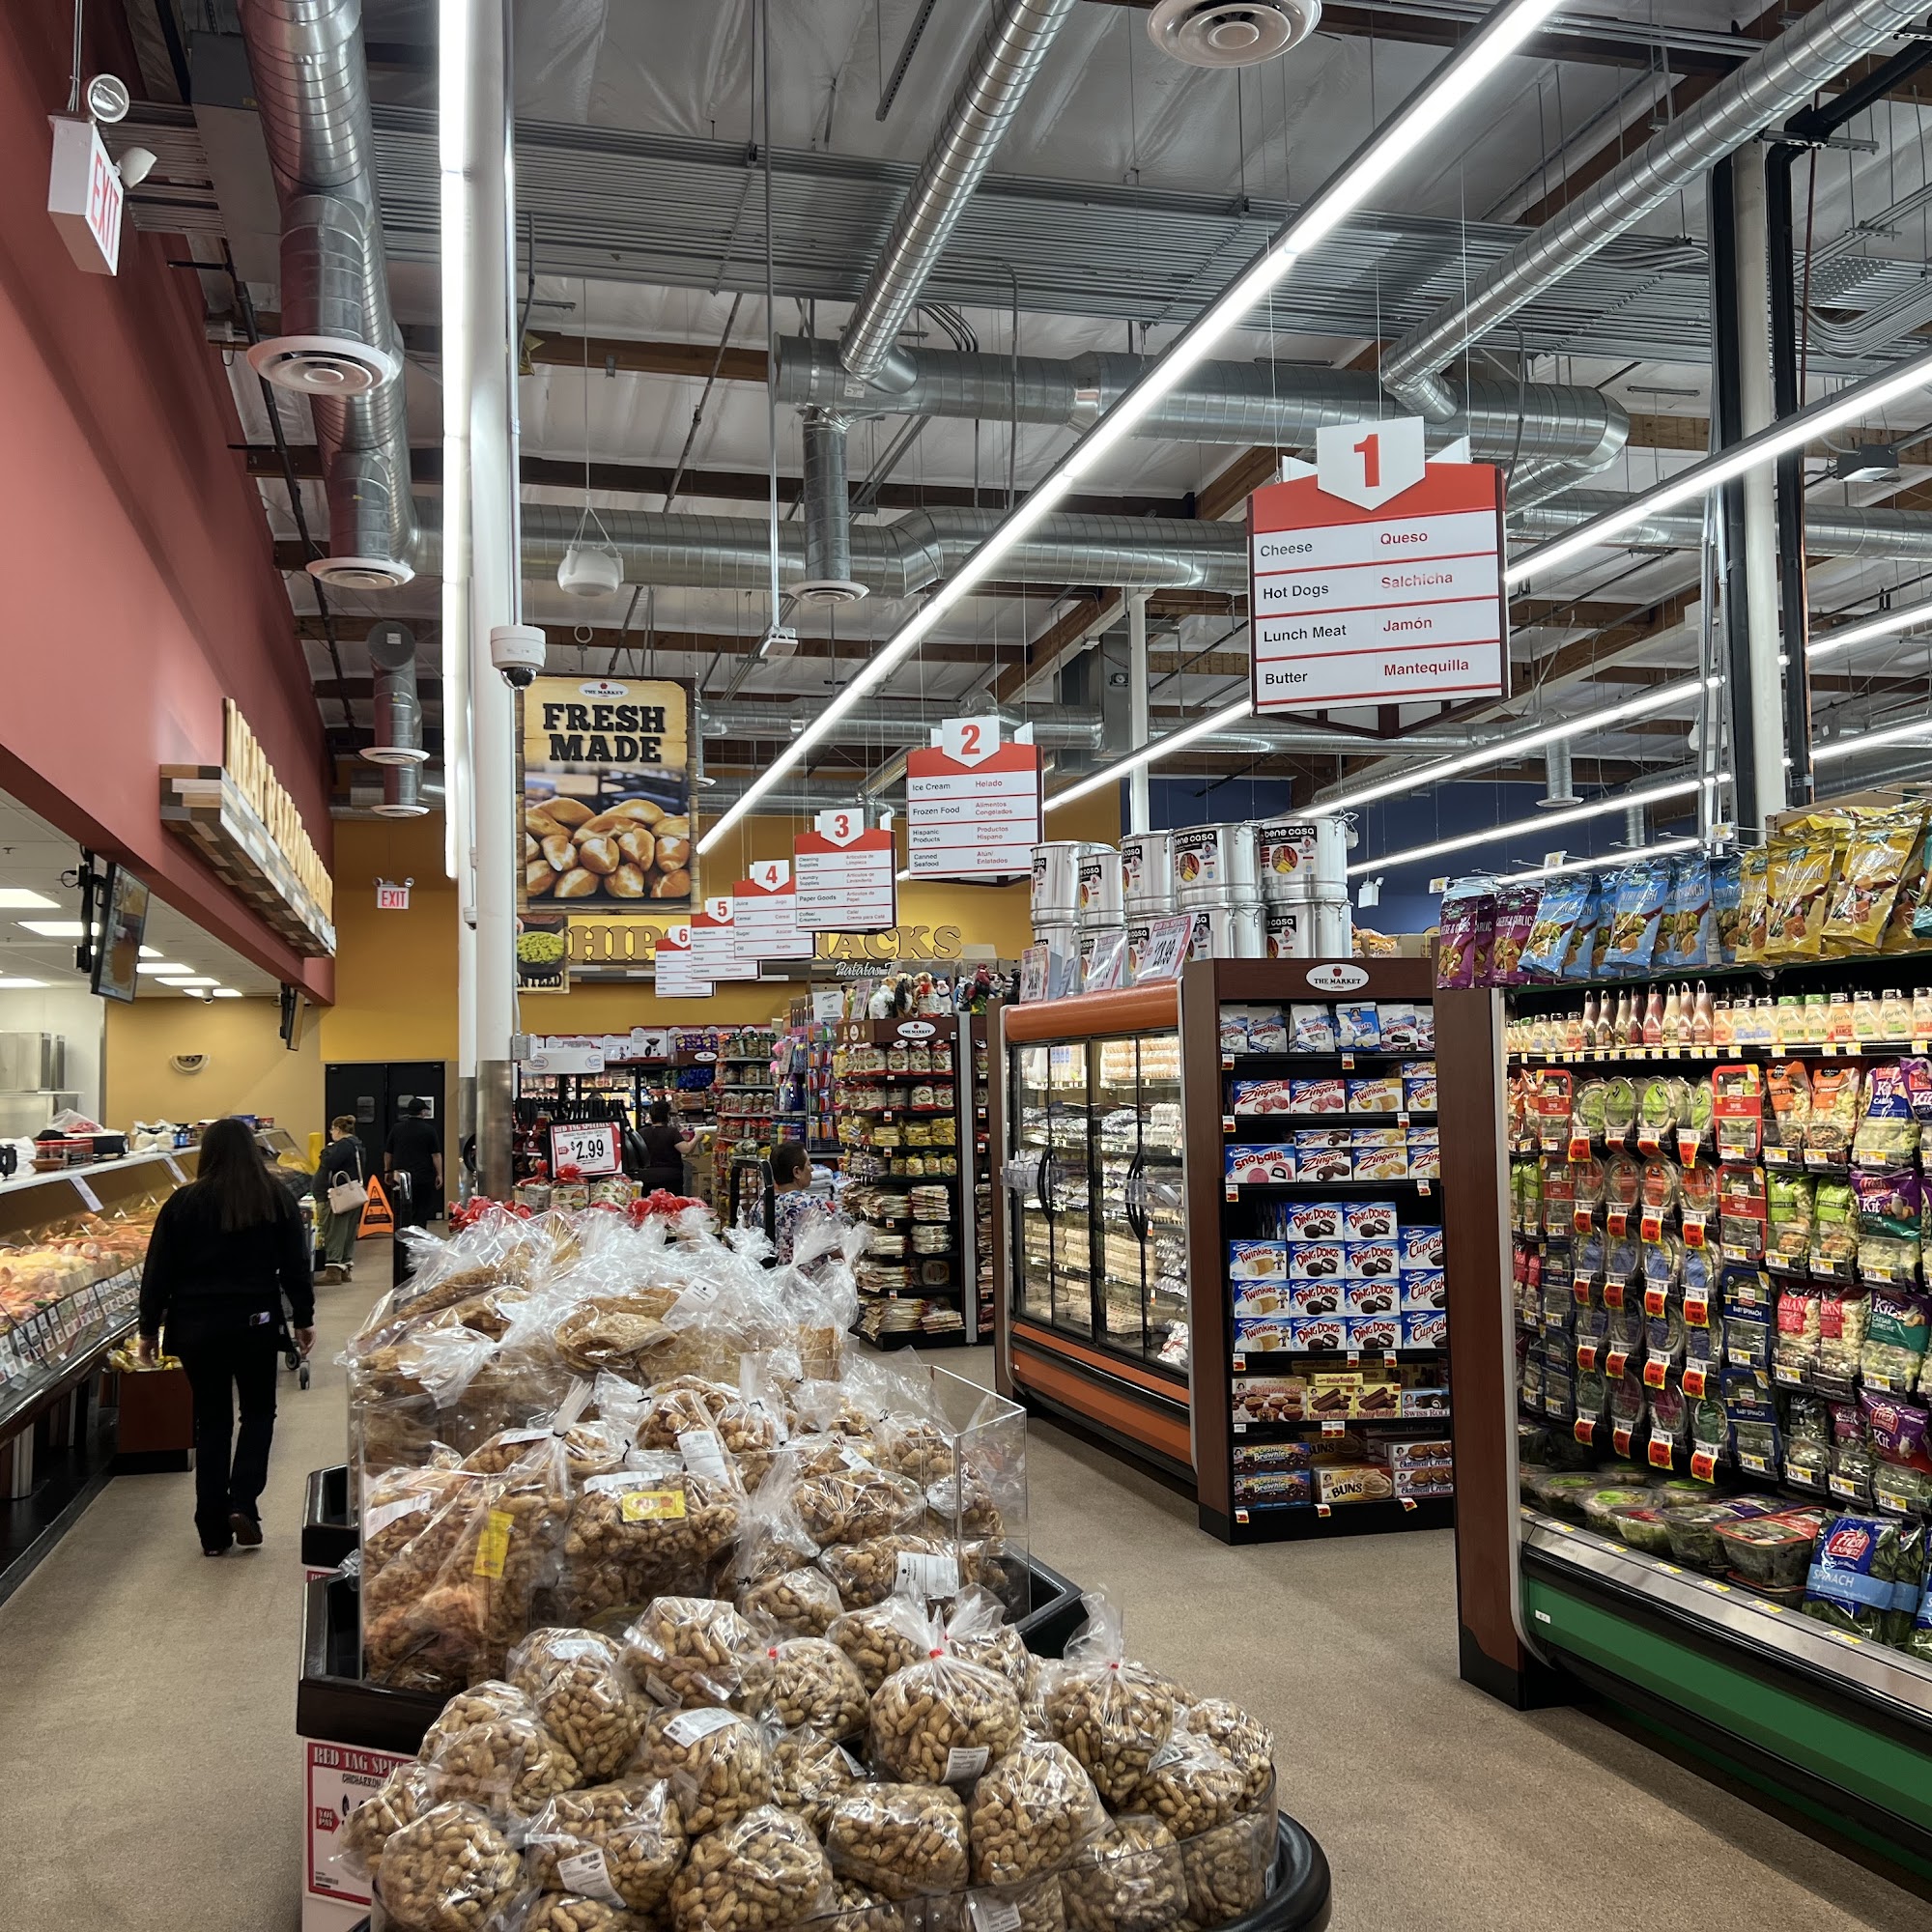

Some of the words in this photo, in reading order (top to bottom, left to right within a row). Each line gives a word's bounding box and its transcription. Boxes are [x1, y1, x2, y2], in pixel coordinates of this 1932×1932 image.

[90, 150, 120, 262] EXIT
[1353, 433, 1379, 488] 1
[1380, 532, 1428, 546] Queso
[1260, 542, 1313, 557] Cheese
[1380, 572, 1453, 588] Salchicha
[1263, 586, 1288, 600] Hot
[1292, 583, 1329, 598] Dogs
[1383, 616, 1433, 632] Jamón
[1264, 628, 1308, 642] Lunch
[1312, 624, 1347, 639] Meat
[1384, 659, 1469, 676] Mantequilla
[1264, 670, 1308, 685] Butter
[543, 703, 666, 733] FRESH
[960, 724, 980, 755] 2
[549, 733, 662, 763] MADE
[834, 814, 849, 838] 3
[1264, 828, 1287, 838] bene
[1289, 827, 1315, 837] casa
[1189, 833, 1214, 842] casa
[765, 865, 778, 884] 4
[382, 890, 406, 907] EXIT
[717, 900, 727, 917] 5
[1270, 918, 1293, 926] casa
[568, 925, 668, 960] HIP
[679, 928, 689, 943] 6
[835, 961, 882, 977] Patatas
[1240, 1085, 1282, 1105] Zingers
[1296, 1085, 1337, 1104] Zingers
[1353, 1086, 1386, 1102] Twinkies
[1361, 1133, 1384, 1144] Zingers
[570, 1139, 604, 1160] $2.99
[1302, 1152, 1343, 1173] Zingers
[1359, 1151, 1399, 1171] Zingers
[1861, 1196, 1883, 1212] Kit
[1314, 1208, 1337, 1219] DONGS
[1368, 1208, 1391, 1219] DONGS
[1238, 1247, 1273, 1264] Twinkies
[1316, 1246, 1339, 1258] DONGS
[1371, 1246, 1393, 1258] DONGS
[1242, 1285, 1276, 1302] Twinkies
[1316, 1285, 1339, 1295] DONGS
[1371, 1284, 1393, 1294] DONGS
[1873, 1294, 1894, 1316] Kit
[1317, 1322, 1340, 1333] DONGS
[1373, 1321, 1396, 1332] DONGS
[1872, 1315, 1891, 1324] CAESAR
[1243, 1323, 1277, 1341] Twinkies
[1872, 1428, 1890, 1449] Kit
[1254, 1451, 1290, 1462] Brownies
[1254, 1482, 1290, 1492] Brownies
[1331, 1483, 1363, 1498] BUNS
[1812, 1569, 1855, 1587] SPINACH
[314, 1747, 340, 1766] RED
[343, 1751, 368, 1771] TAG
